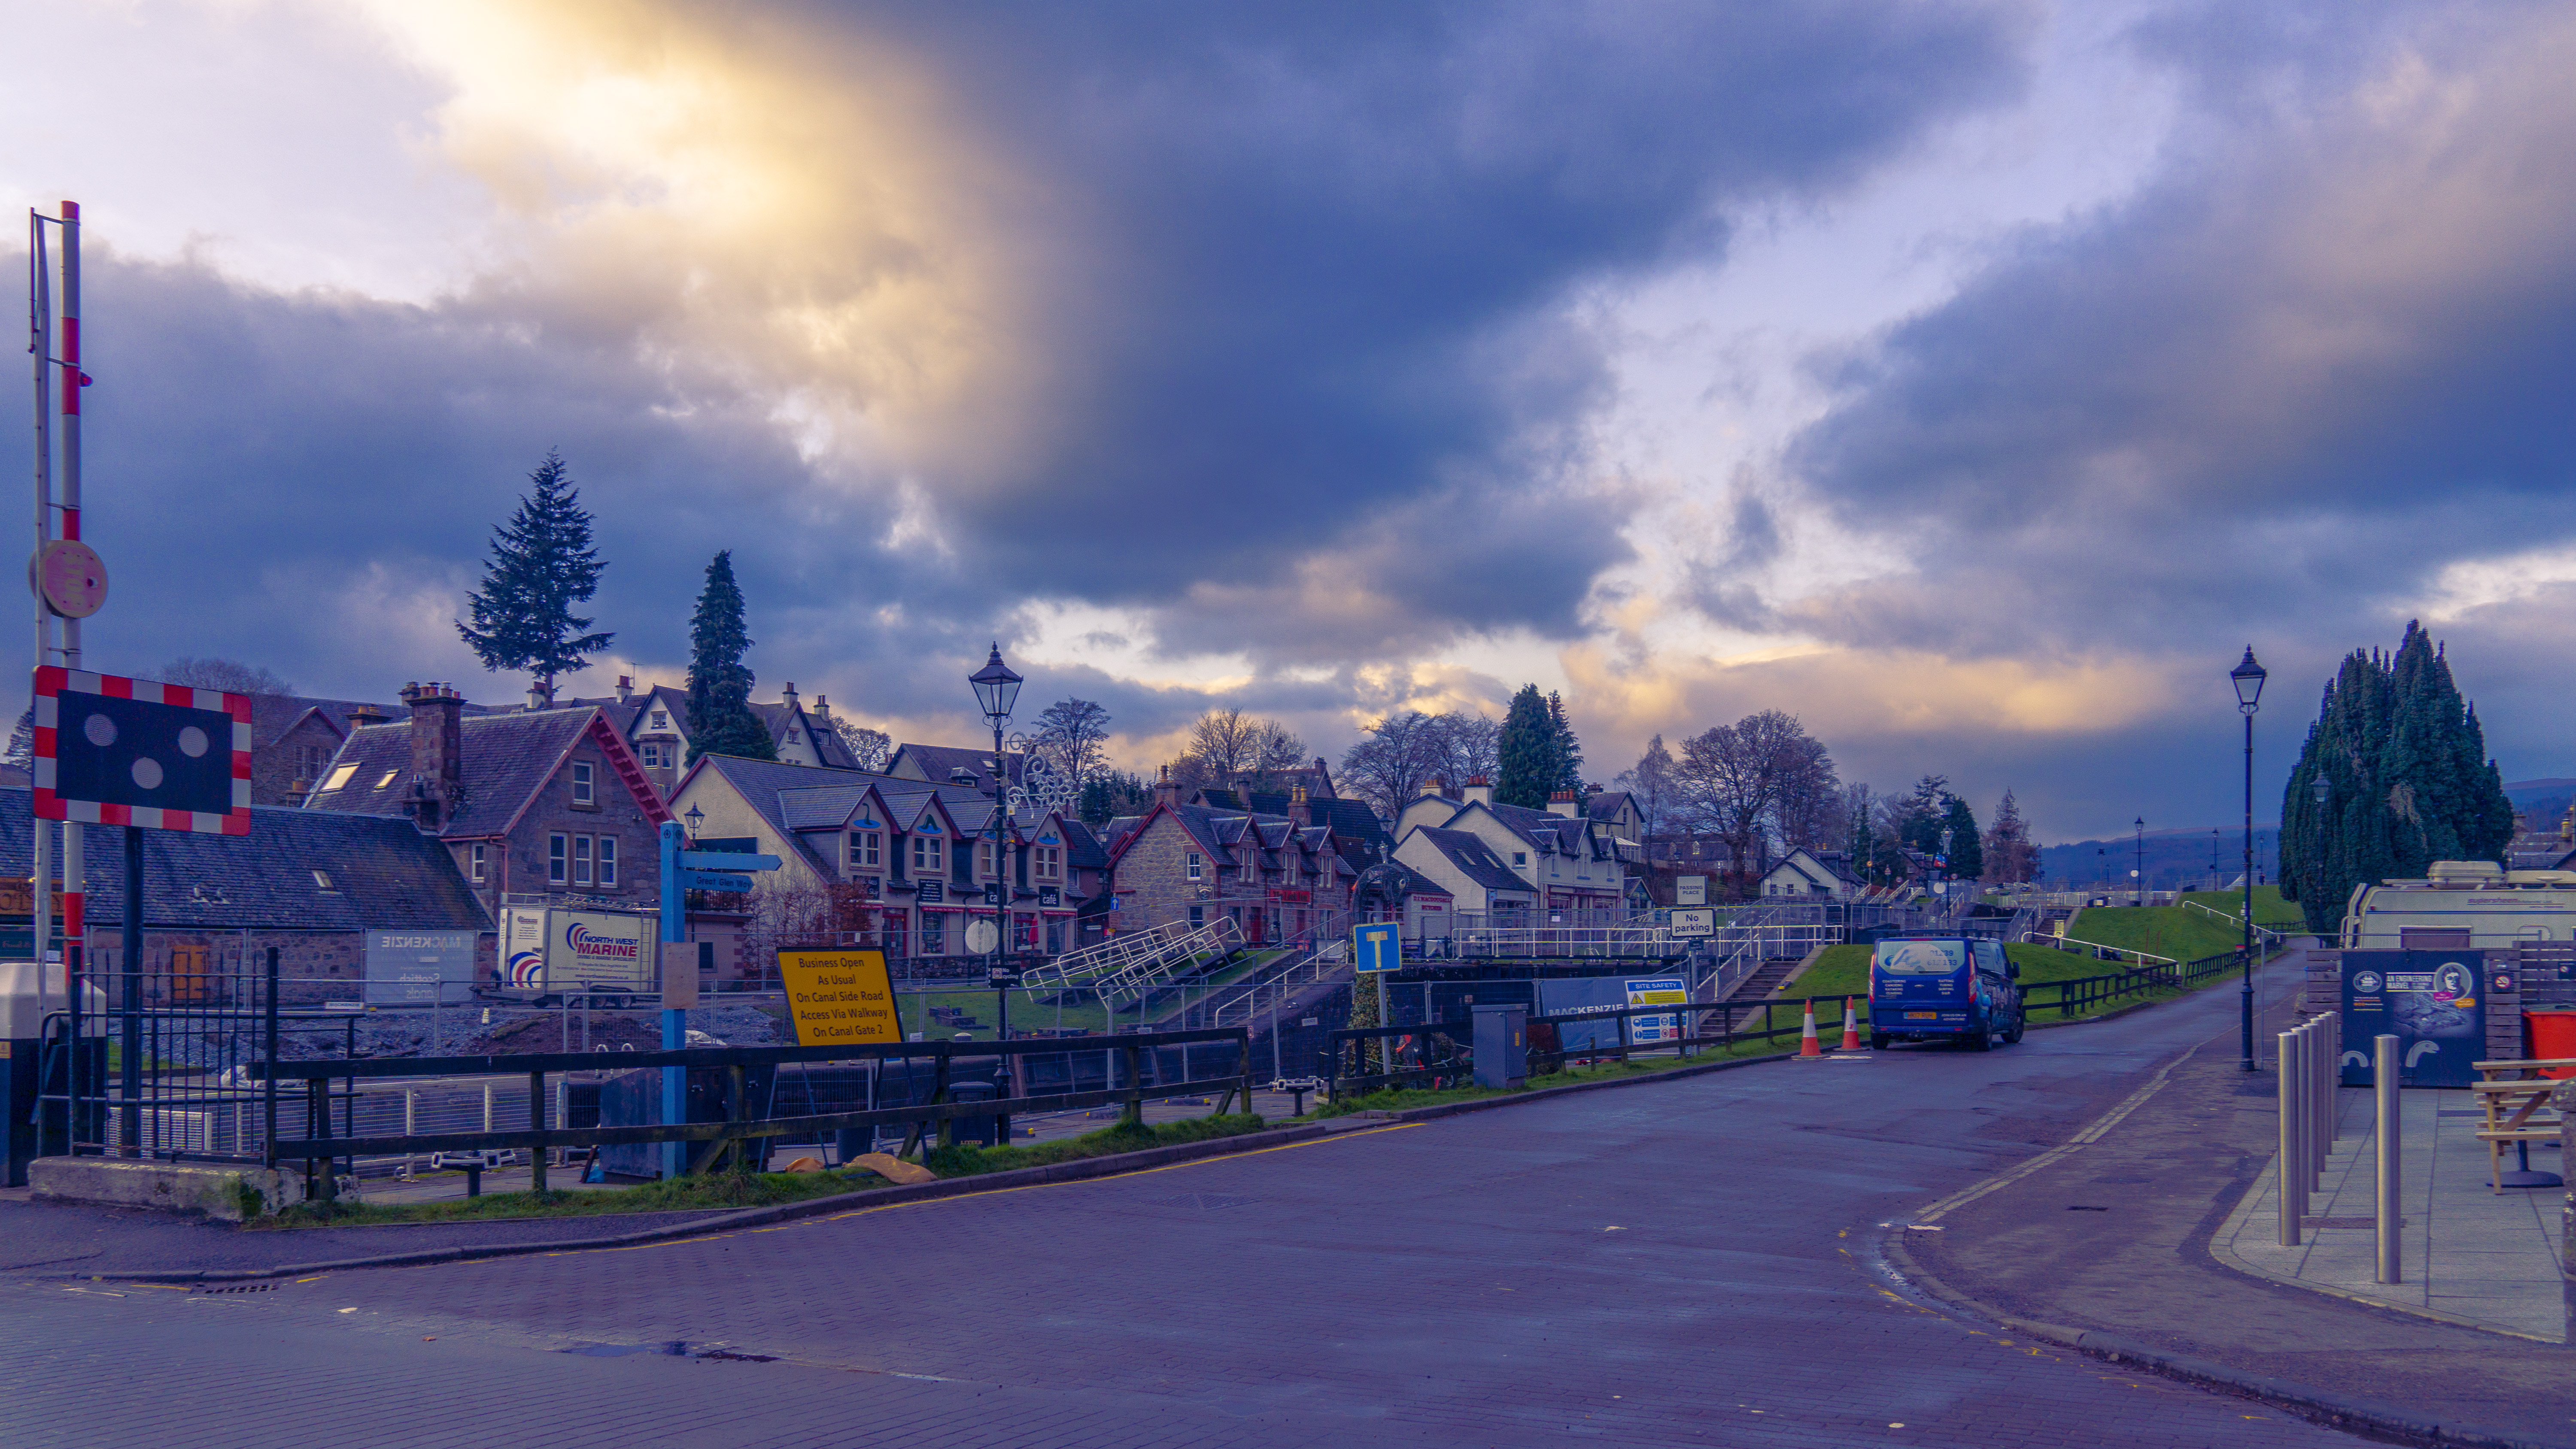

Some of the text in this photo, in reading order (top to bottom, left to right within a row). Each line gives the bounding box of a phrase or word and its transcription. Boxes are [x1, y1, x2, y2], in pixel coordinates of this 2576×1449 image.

[697, 876, 751, 889] Great Glen Way
[1042, 894, 1057, 904] café
[1675, 924, 1710, 933] parking
[584, 936, 614, 944] NORTH
[577, 943, 638, 957] MARINE
[799, 958, 864, 970] Business Open
[818, 974, 856, 985] As Usual
[796, 990, 884, 1002] On Canal Side Road
[801, 1007, 887, 1020] Access Via Walkway
[1549, 1004, 1624, 1016] MACKENZIE
[813, 1024, 883, 1037] On Canal Gate 2
